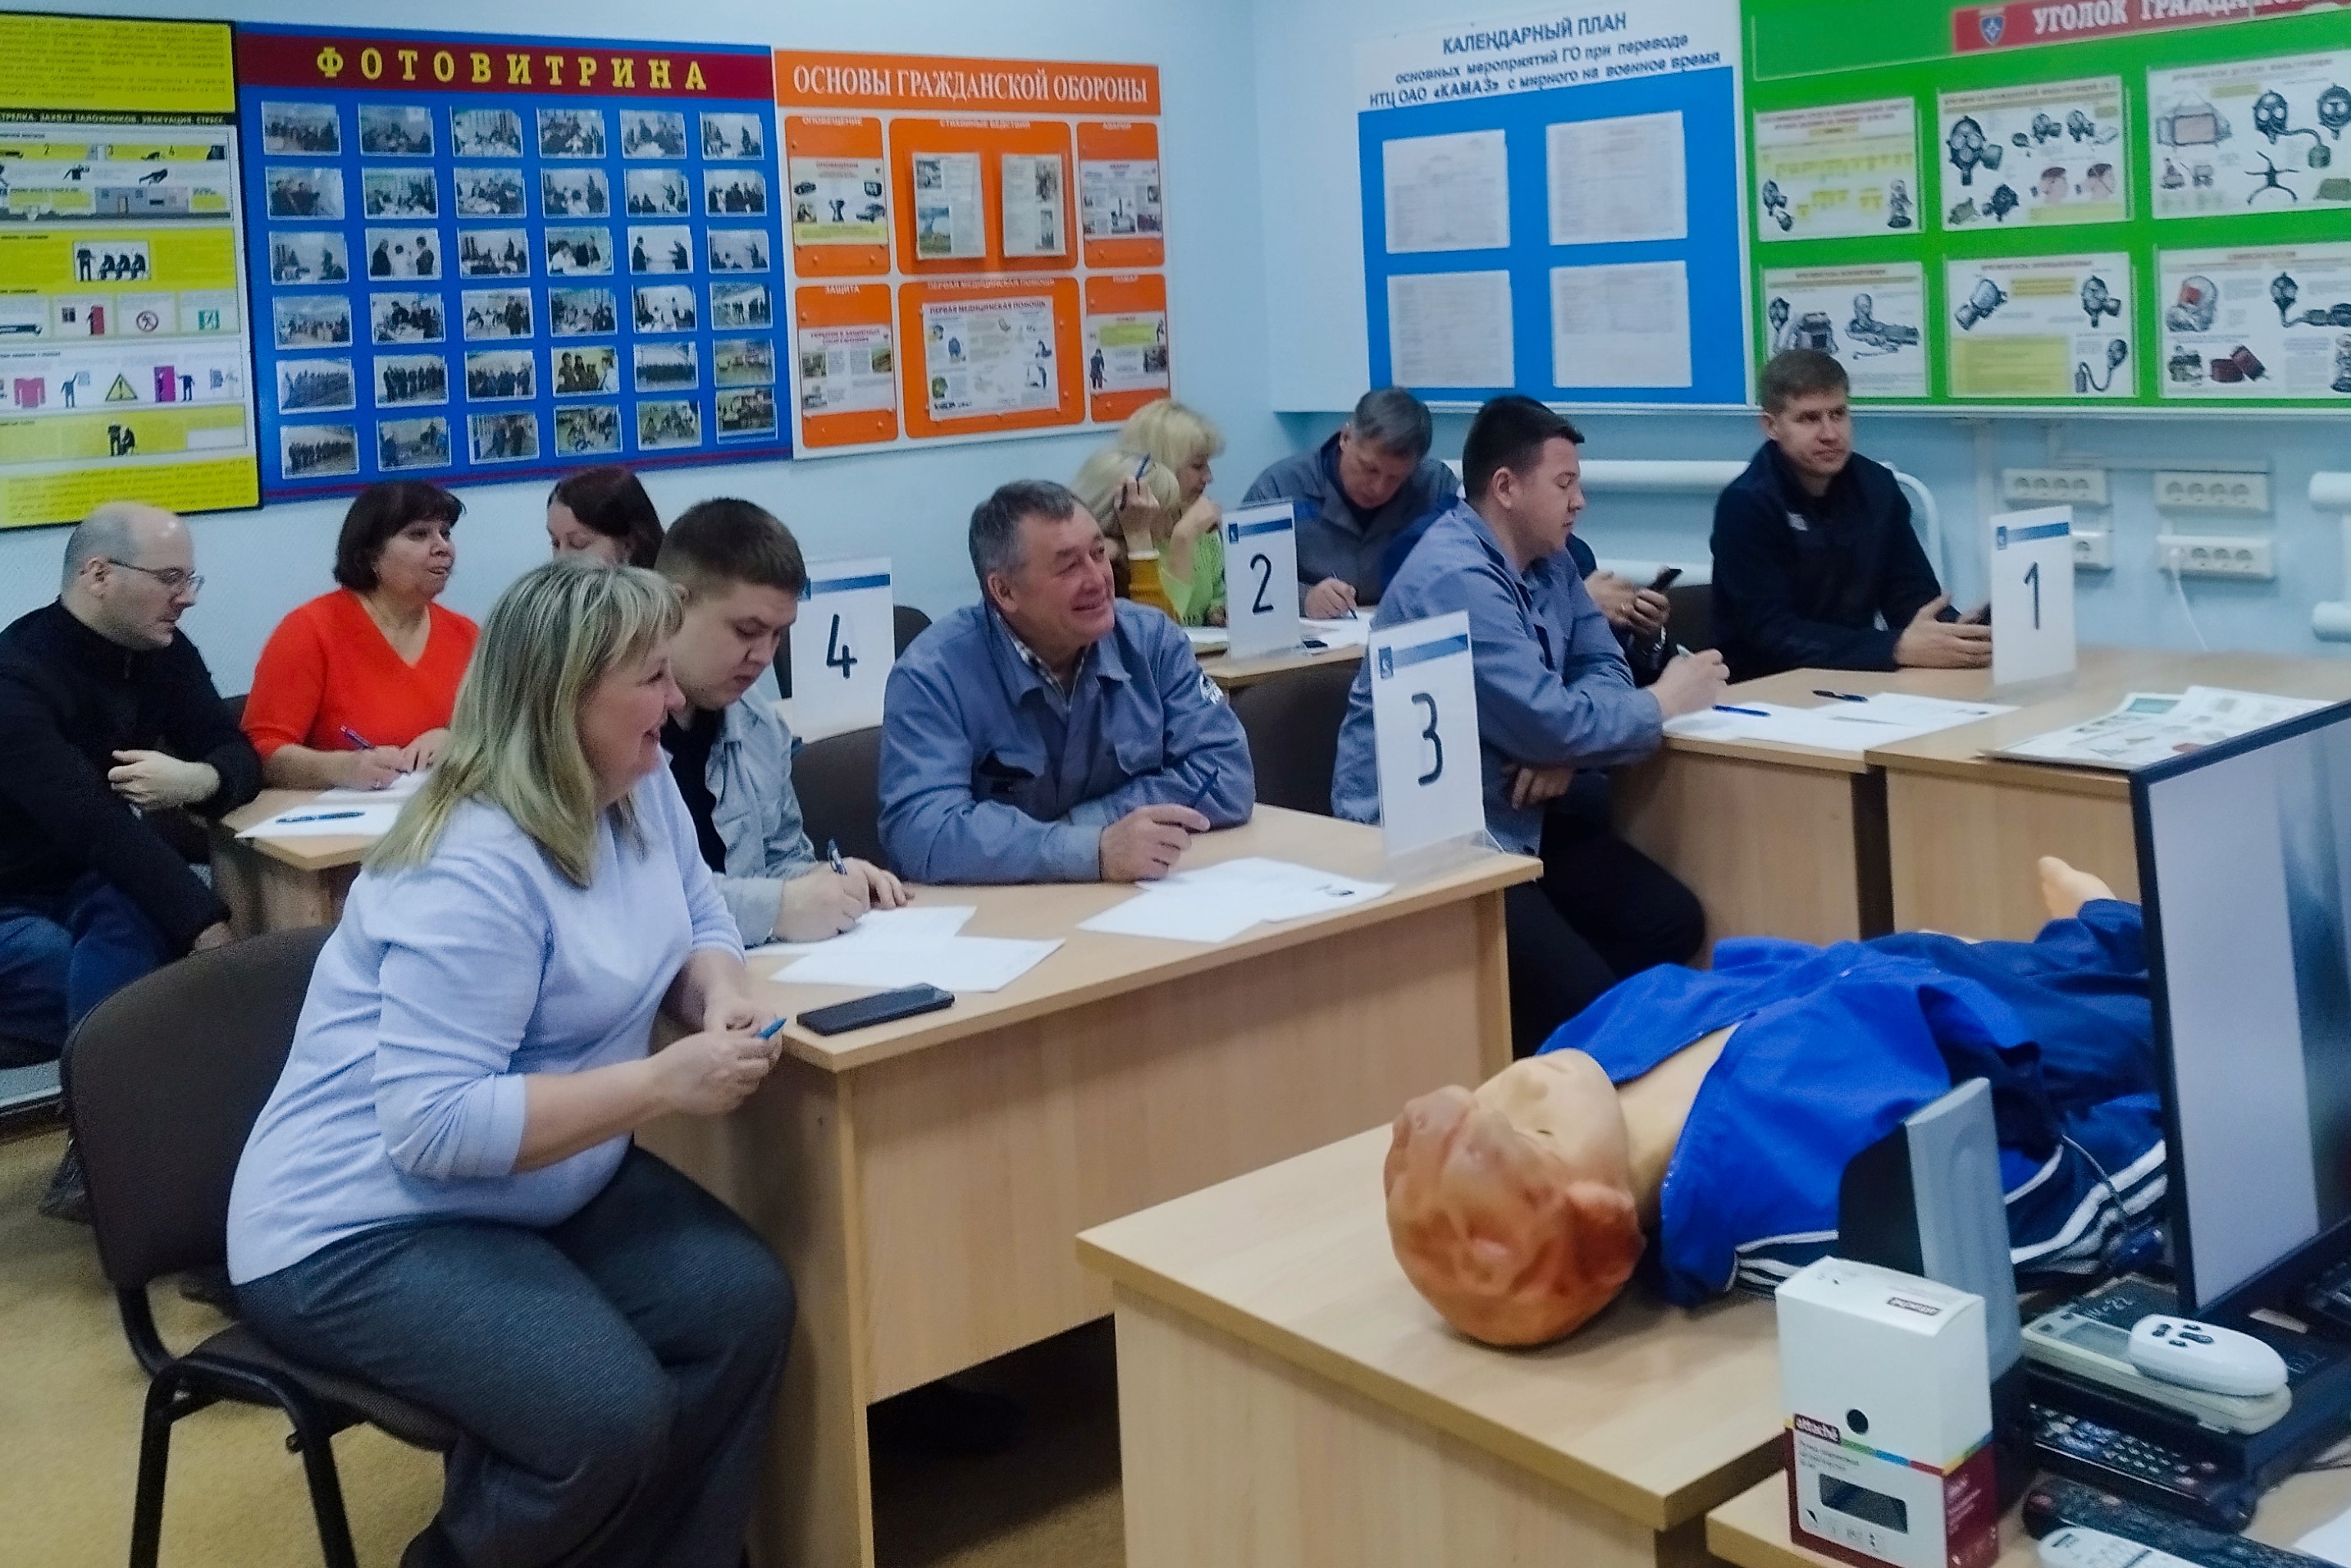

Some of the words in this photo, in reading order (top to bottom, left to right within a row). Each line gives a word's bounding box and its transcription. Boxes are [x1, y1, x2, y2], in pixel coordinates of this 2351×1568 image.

[1443, 16, 1573, 54] КАЛЕНДАРНЫЙ
[1578, 11, 1627, 36] ПЛАН
[2032, 0, 2129, 34] УГОЛОК
[317, 46, 706, 91] ФОТОВИТРИНА
[793, 66, 892, 97] ОСНОВЫ
[897, 68, 1050, 103] ГРАЖДАНСКОЙ
[1053, 74, 1148, 103] ОБОРОНЫ
[1369, 90, 1395, 107] НТЦ
[1399, 87, 1427, 104] ОАО
[1434, 78, 1499, 99] «КАМАЗ»
[1508, 79, 1516, 90] с
[1519, 69, 1578, 90] мирного
[1582, 67, 1599, 80] на
[1605, 58, 1666, 78] военное
[1670, 52, 1721, 74] время
[1395, 66, 1460, 84] основных
[1467, 49, 1559, 78] мероприятий
[1562, 46, 1581, 62] ГО
[1585, 45, 1611, 61] при
[1618, 34, 1689, 56] переводе
[1250, 554, 1274, 614] 2
[2023, 561, 2039, 631] 1
[826, 613, 858, 680] 4
[1411, 692, 1444, 787] 3
